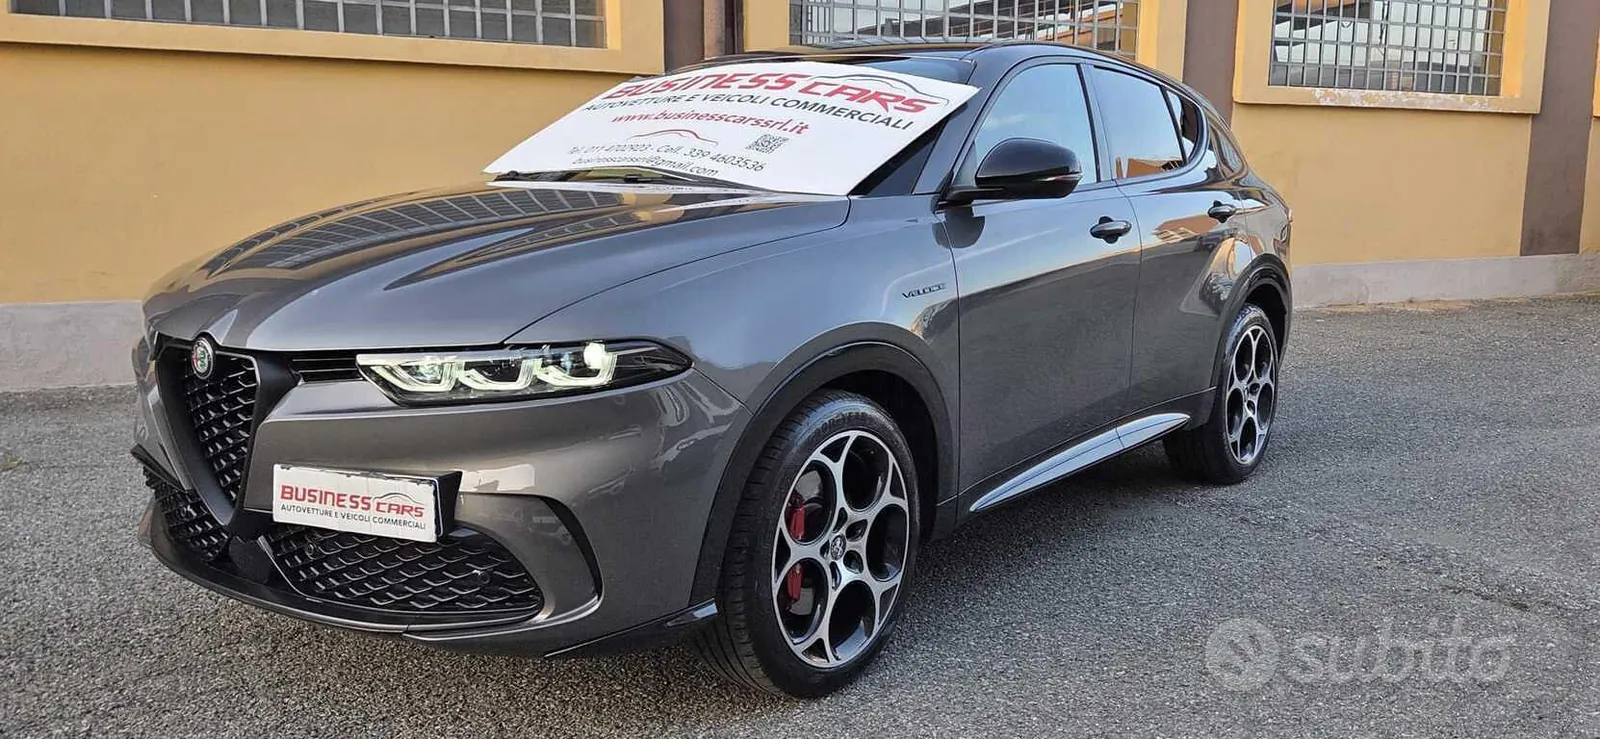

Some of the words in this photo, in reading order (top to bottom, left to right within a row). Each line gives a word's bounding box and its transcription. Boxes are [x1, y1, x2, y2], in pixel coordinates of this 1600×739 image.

[602, 73, 812, 99] BUSINESS
[799, 81, 940, 113] CARS
[584, 94, 682, 111] AUTOVETTURE
[703, 93, 770, 105] VEICOLI
[771, 97, 914, 130] COMMERCIALI
[611, 110, 809, 134] www.businesscarssrl.it
[710, 153, 767, 172] 4603536
[281, 485, 371, 511] BUSINESS
[375, 501, 425, 520] CARS
[281, 503, 333, 517] AUTOVETTURE
[334, 511, 340, 519] E
[341, 513, 371, 523] VEICOLI
[372, 516, 426, 530] COMMERCIALI
